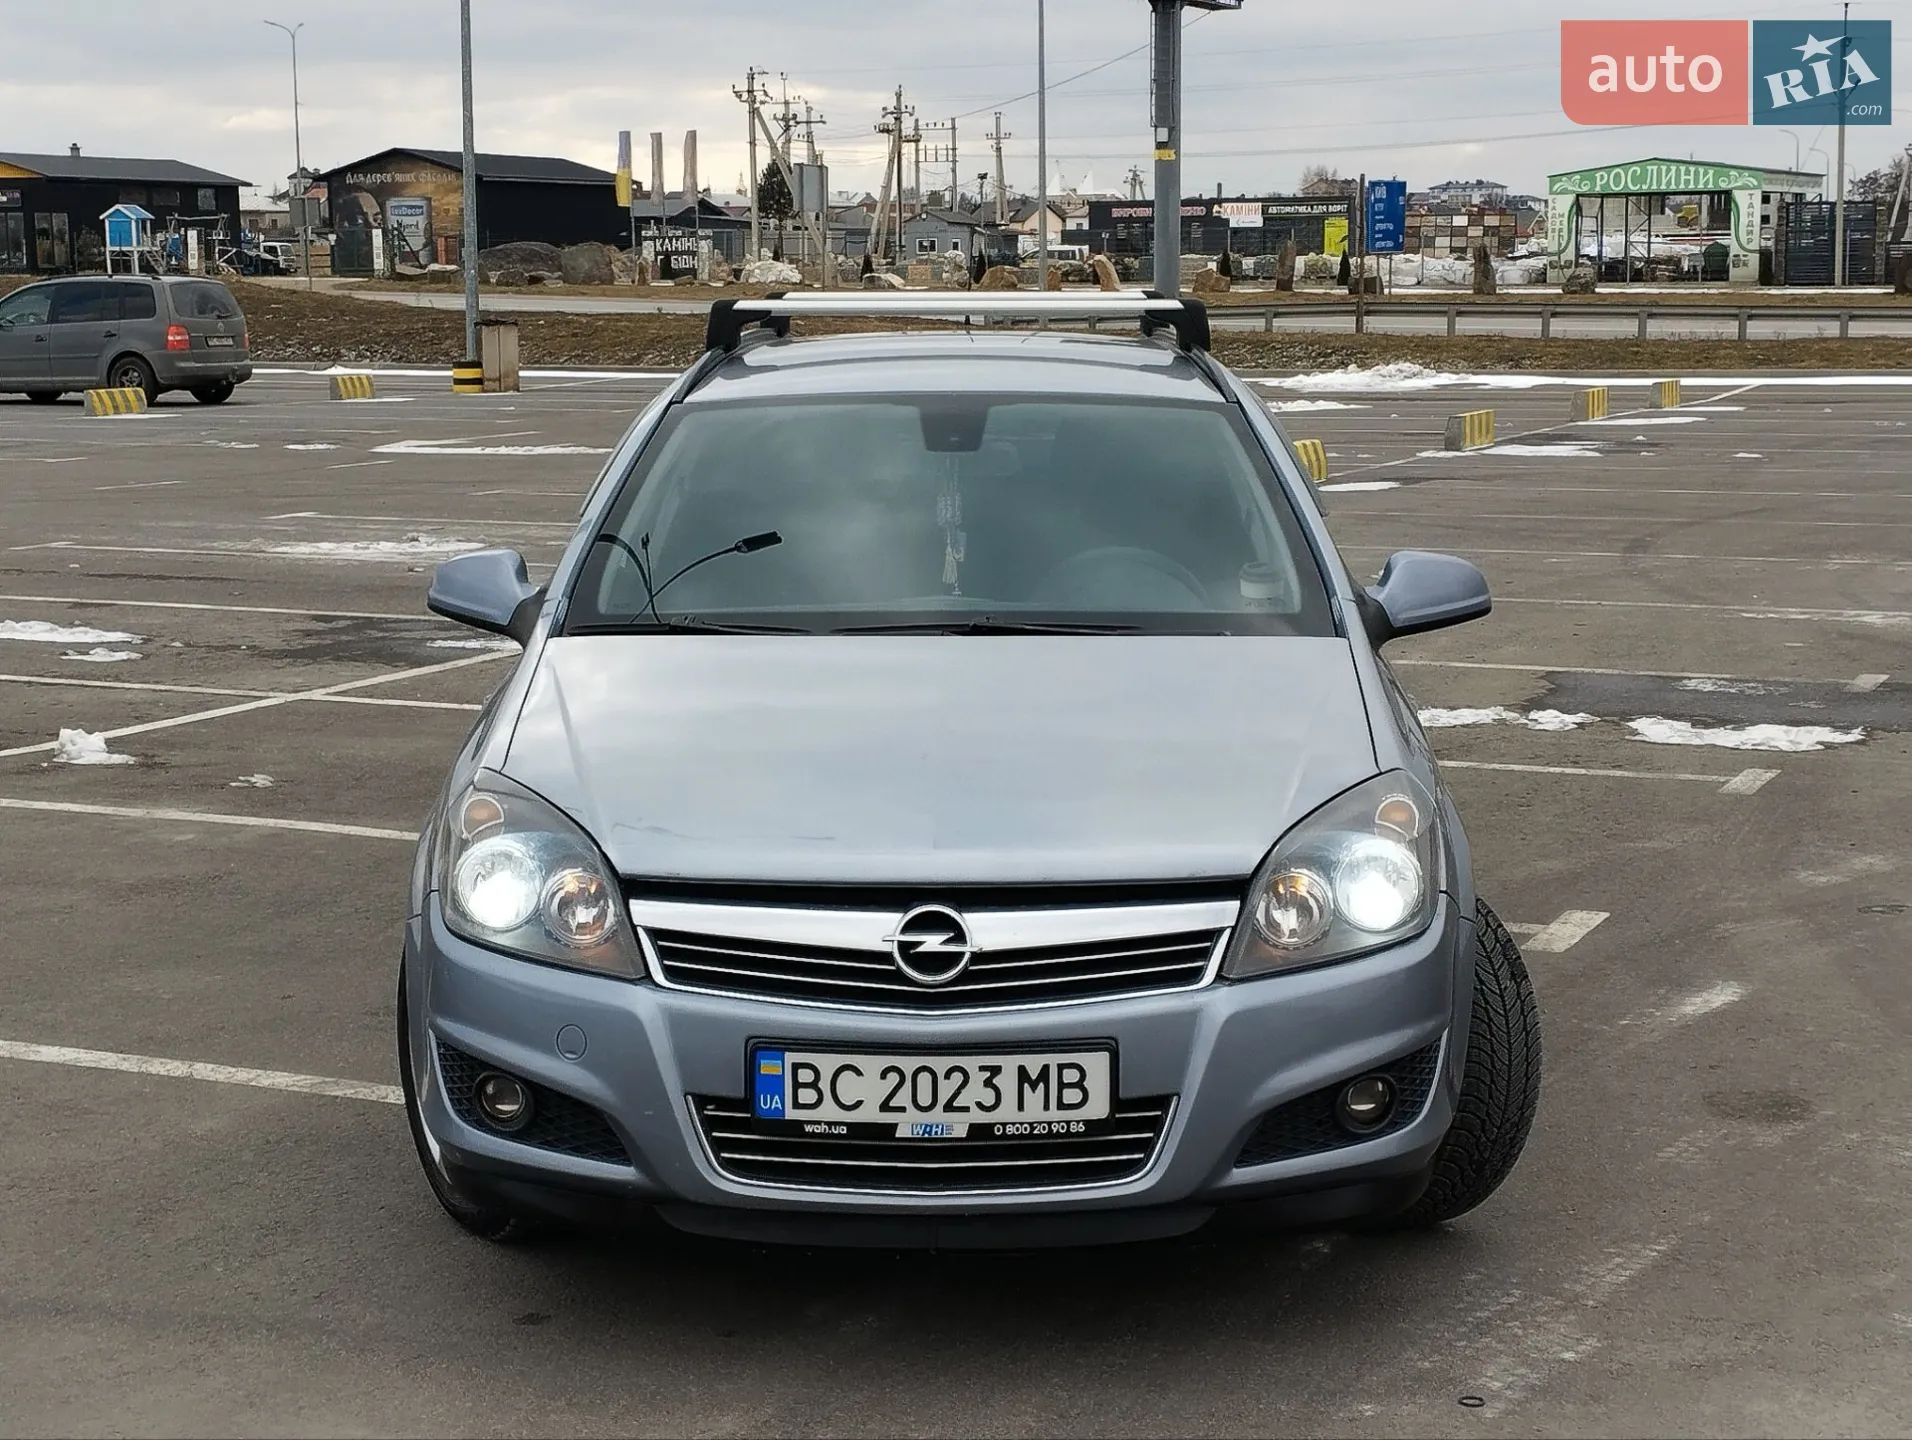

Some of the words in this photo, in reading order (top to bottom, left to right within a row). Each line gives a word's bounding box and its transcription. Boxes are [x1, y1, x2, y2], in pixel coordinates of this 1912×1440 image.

[1594, 165, 1715, 193] РОСЛИНИ
[1222, 204, 1262, 217] КАМІНИ
[1268, 205, 1311, 215] АВТОМАТИКА
[1745, 193, 1756, 246] ТАНДИР
[657, 254, 698, 269] ГБІОН
[791, 1062, 865, 1113] BC
[878, 1063, 1004, 1114] 2023
[1017, 1061, 1090, 1113] MB
[760, 1093, 783, 1111] UA
[803, 1122, 848, 1135] wah.ua
[994, 1124, 1004, 1136] 0
[1005, 1123, 1031, 1135] 800
[1032, 1122, 1049, 1134] 20
[1051, 1121, 1068, 1134] 90
[1069, 1120, 1086, 1133] 86
